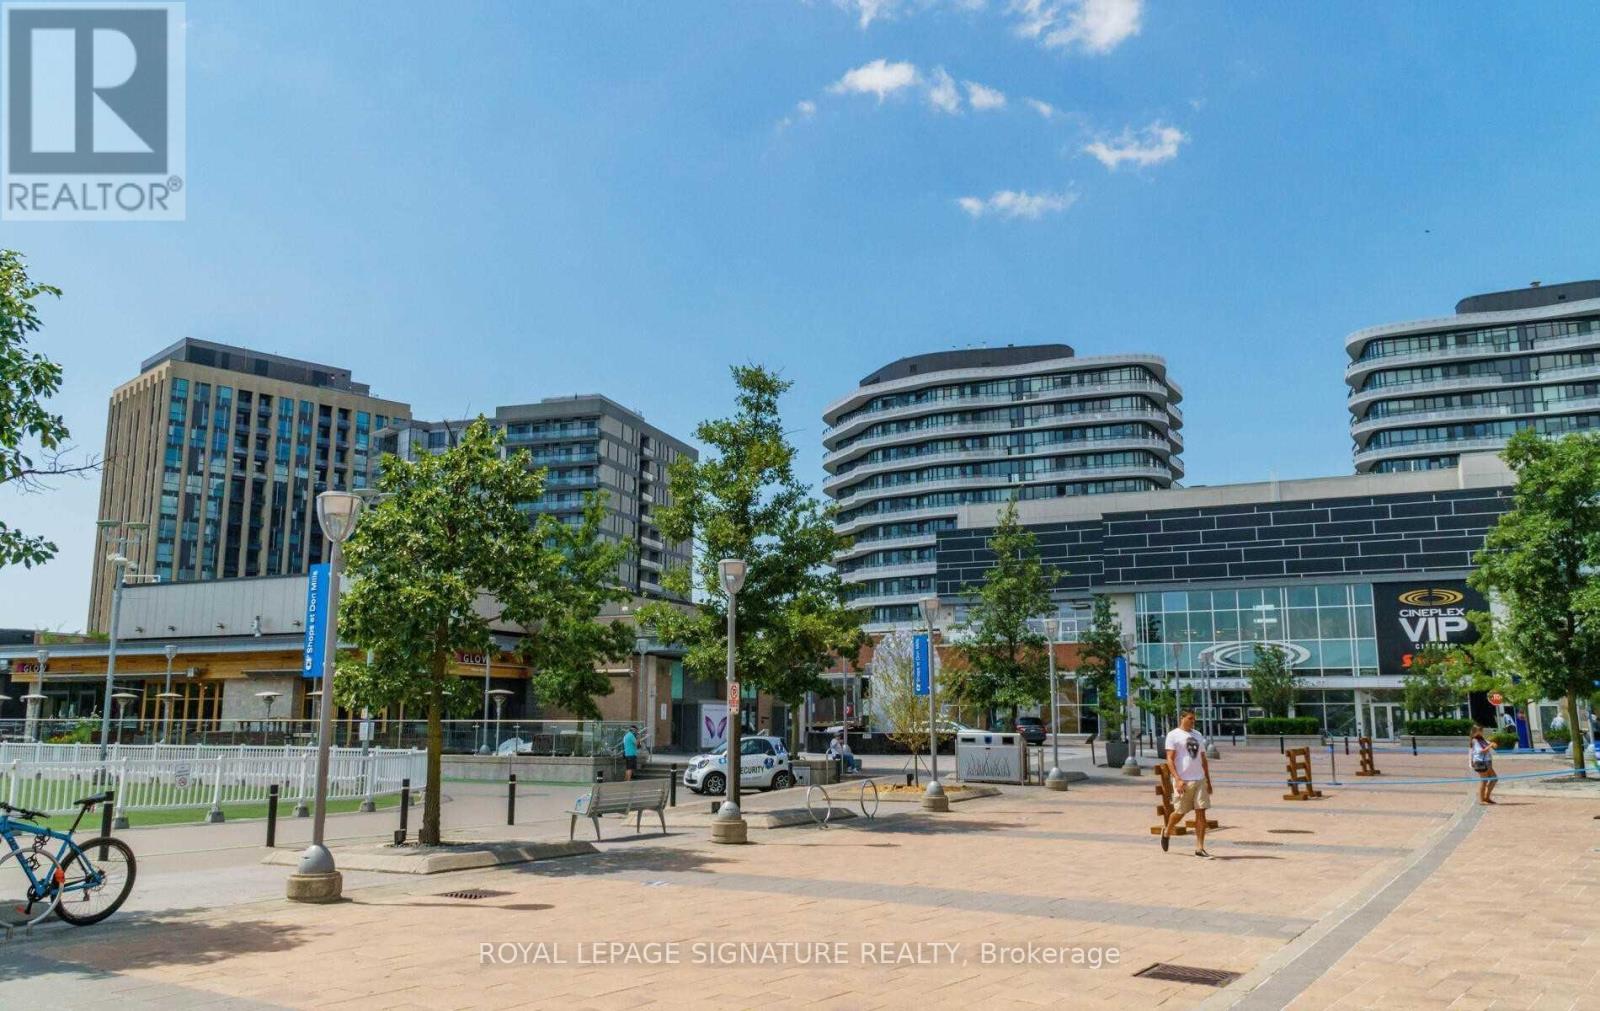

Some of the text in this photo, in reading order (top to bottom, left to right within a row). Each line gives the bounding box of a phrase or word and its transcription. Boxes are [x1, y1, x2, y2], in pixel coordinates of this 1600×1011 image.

[311, 570, 319, 591] Mills
[309, 593, 317, 612] Don
[309, 614, 316, 623] at
[1400, 608, 1465, 617] CINEPLEX
[1398, 617, 1468, 642] VIP
[306, 625, 316, 654] Shops
[740, 766, 764, 775] ECURITY
